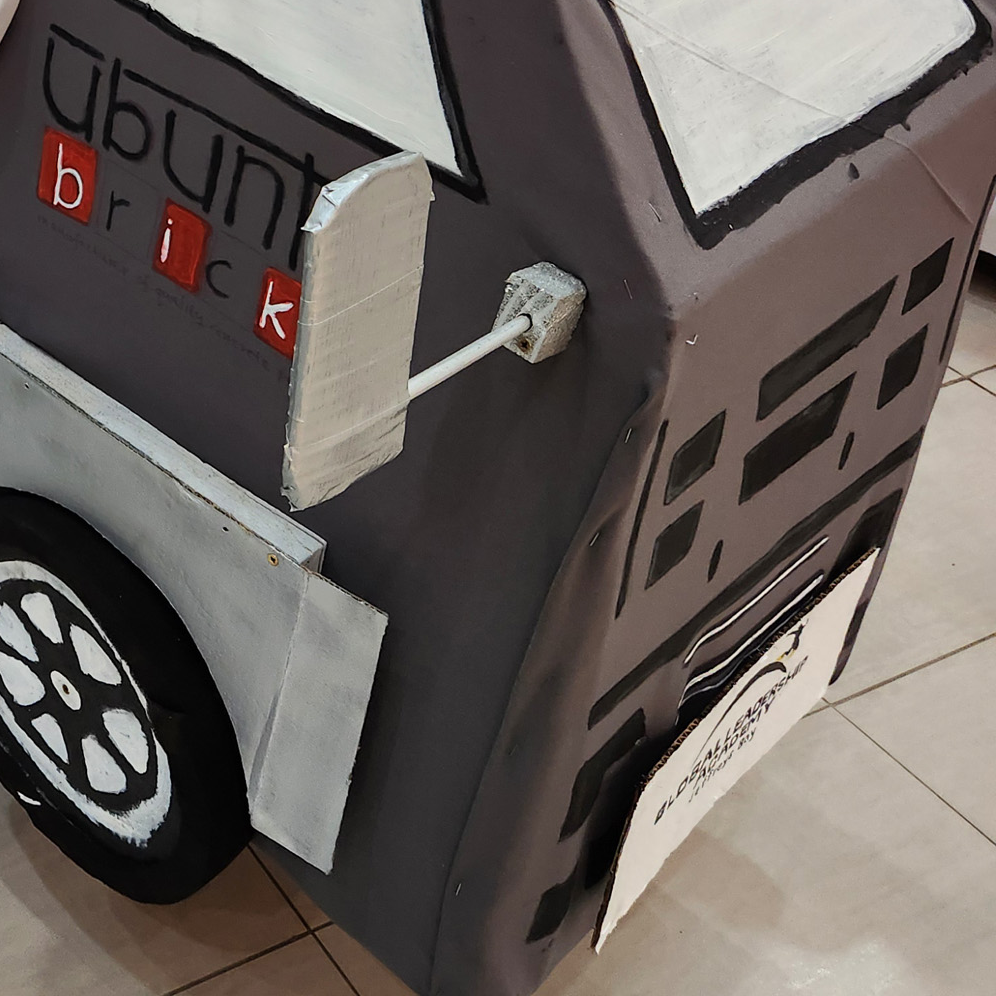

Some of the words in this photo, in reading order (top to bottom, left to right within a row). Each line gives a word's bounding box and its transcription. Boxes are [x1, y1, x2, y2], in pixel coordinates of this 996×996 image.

[654, 739, 722, 825] GLOBAL
[724, 655, 808, 745] LEADERSHIP
[693, 696, 776, 790] ACADEMY
